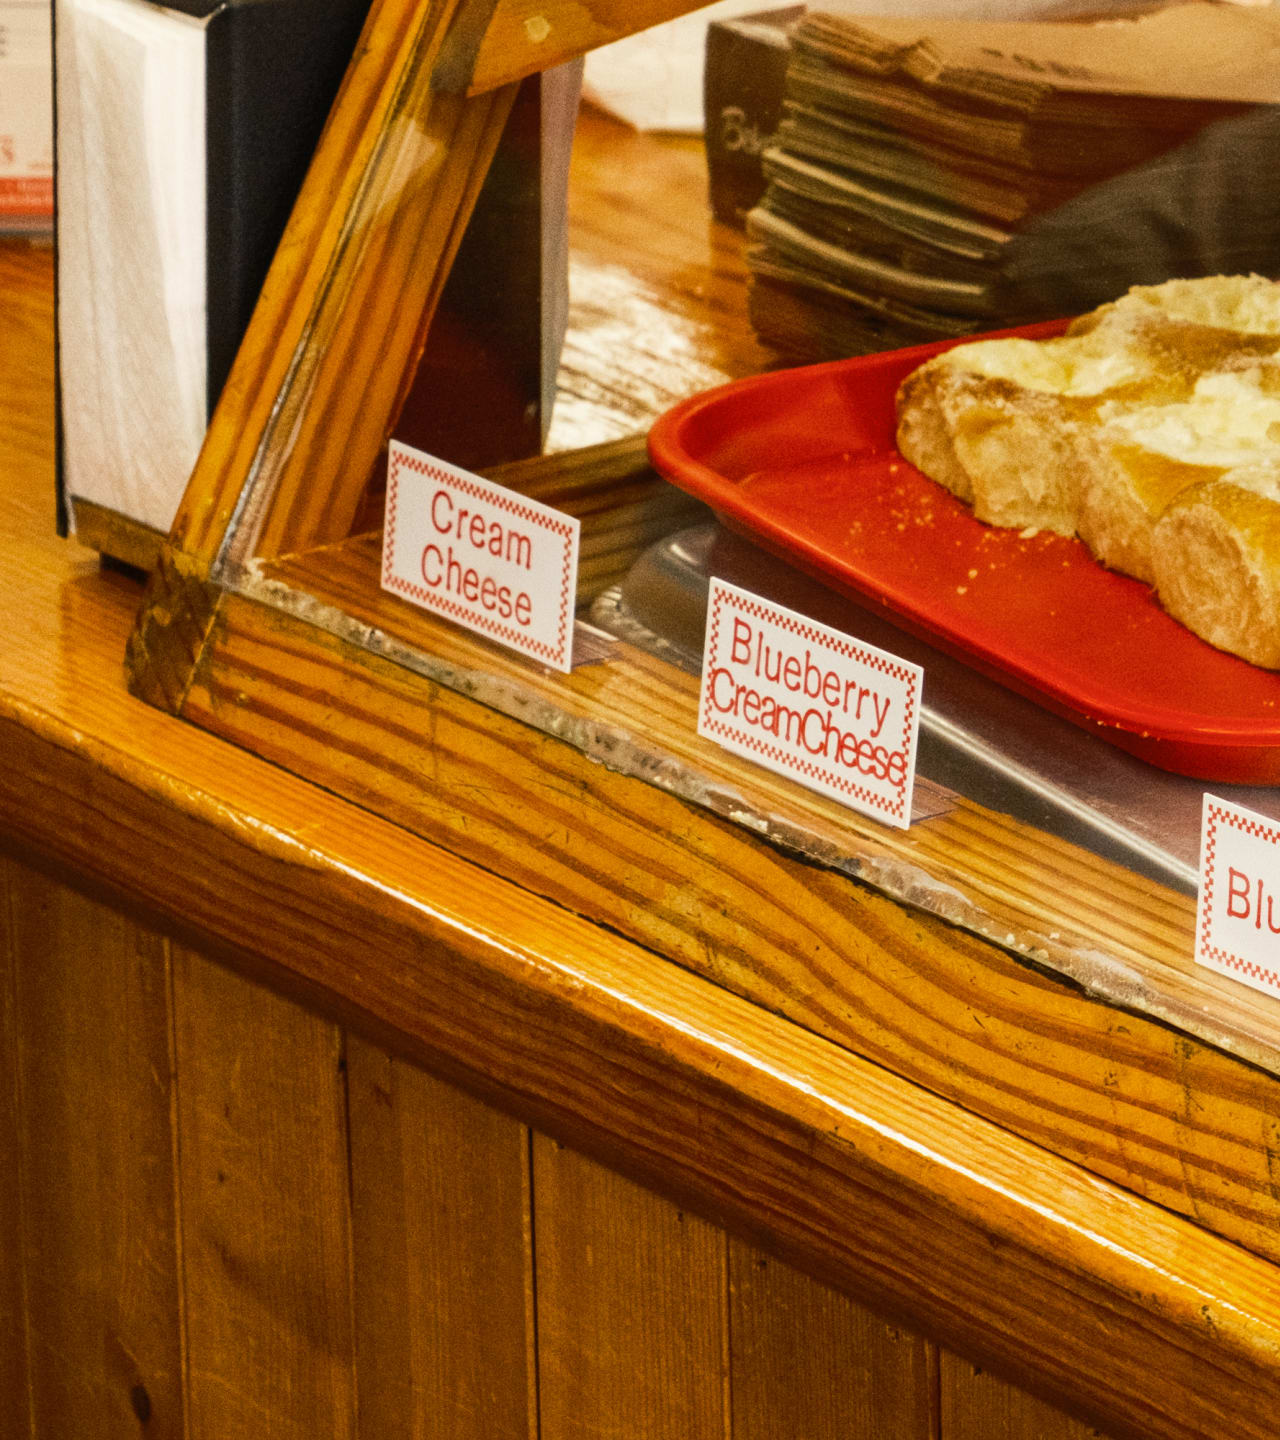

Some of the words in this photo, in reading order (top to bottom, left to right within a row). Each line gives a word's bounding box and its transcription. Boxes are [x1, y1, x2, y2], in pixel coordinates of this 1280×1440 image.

[430, 489, 533, 570] Cream
[420, 543, 533, 626] Cheese
[730, 616, 891, 738] Blueberry
